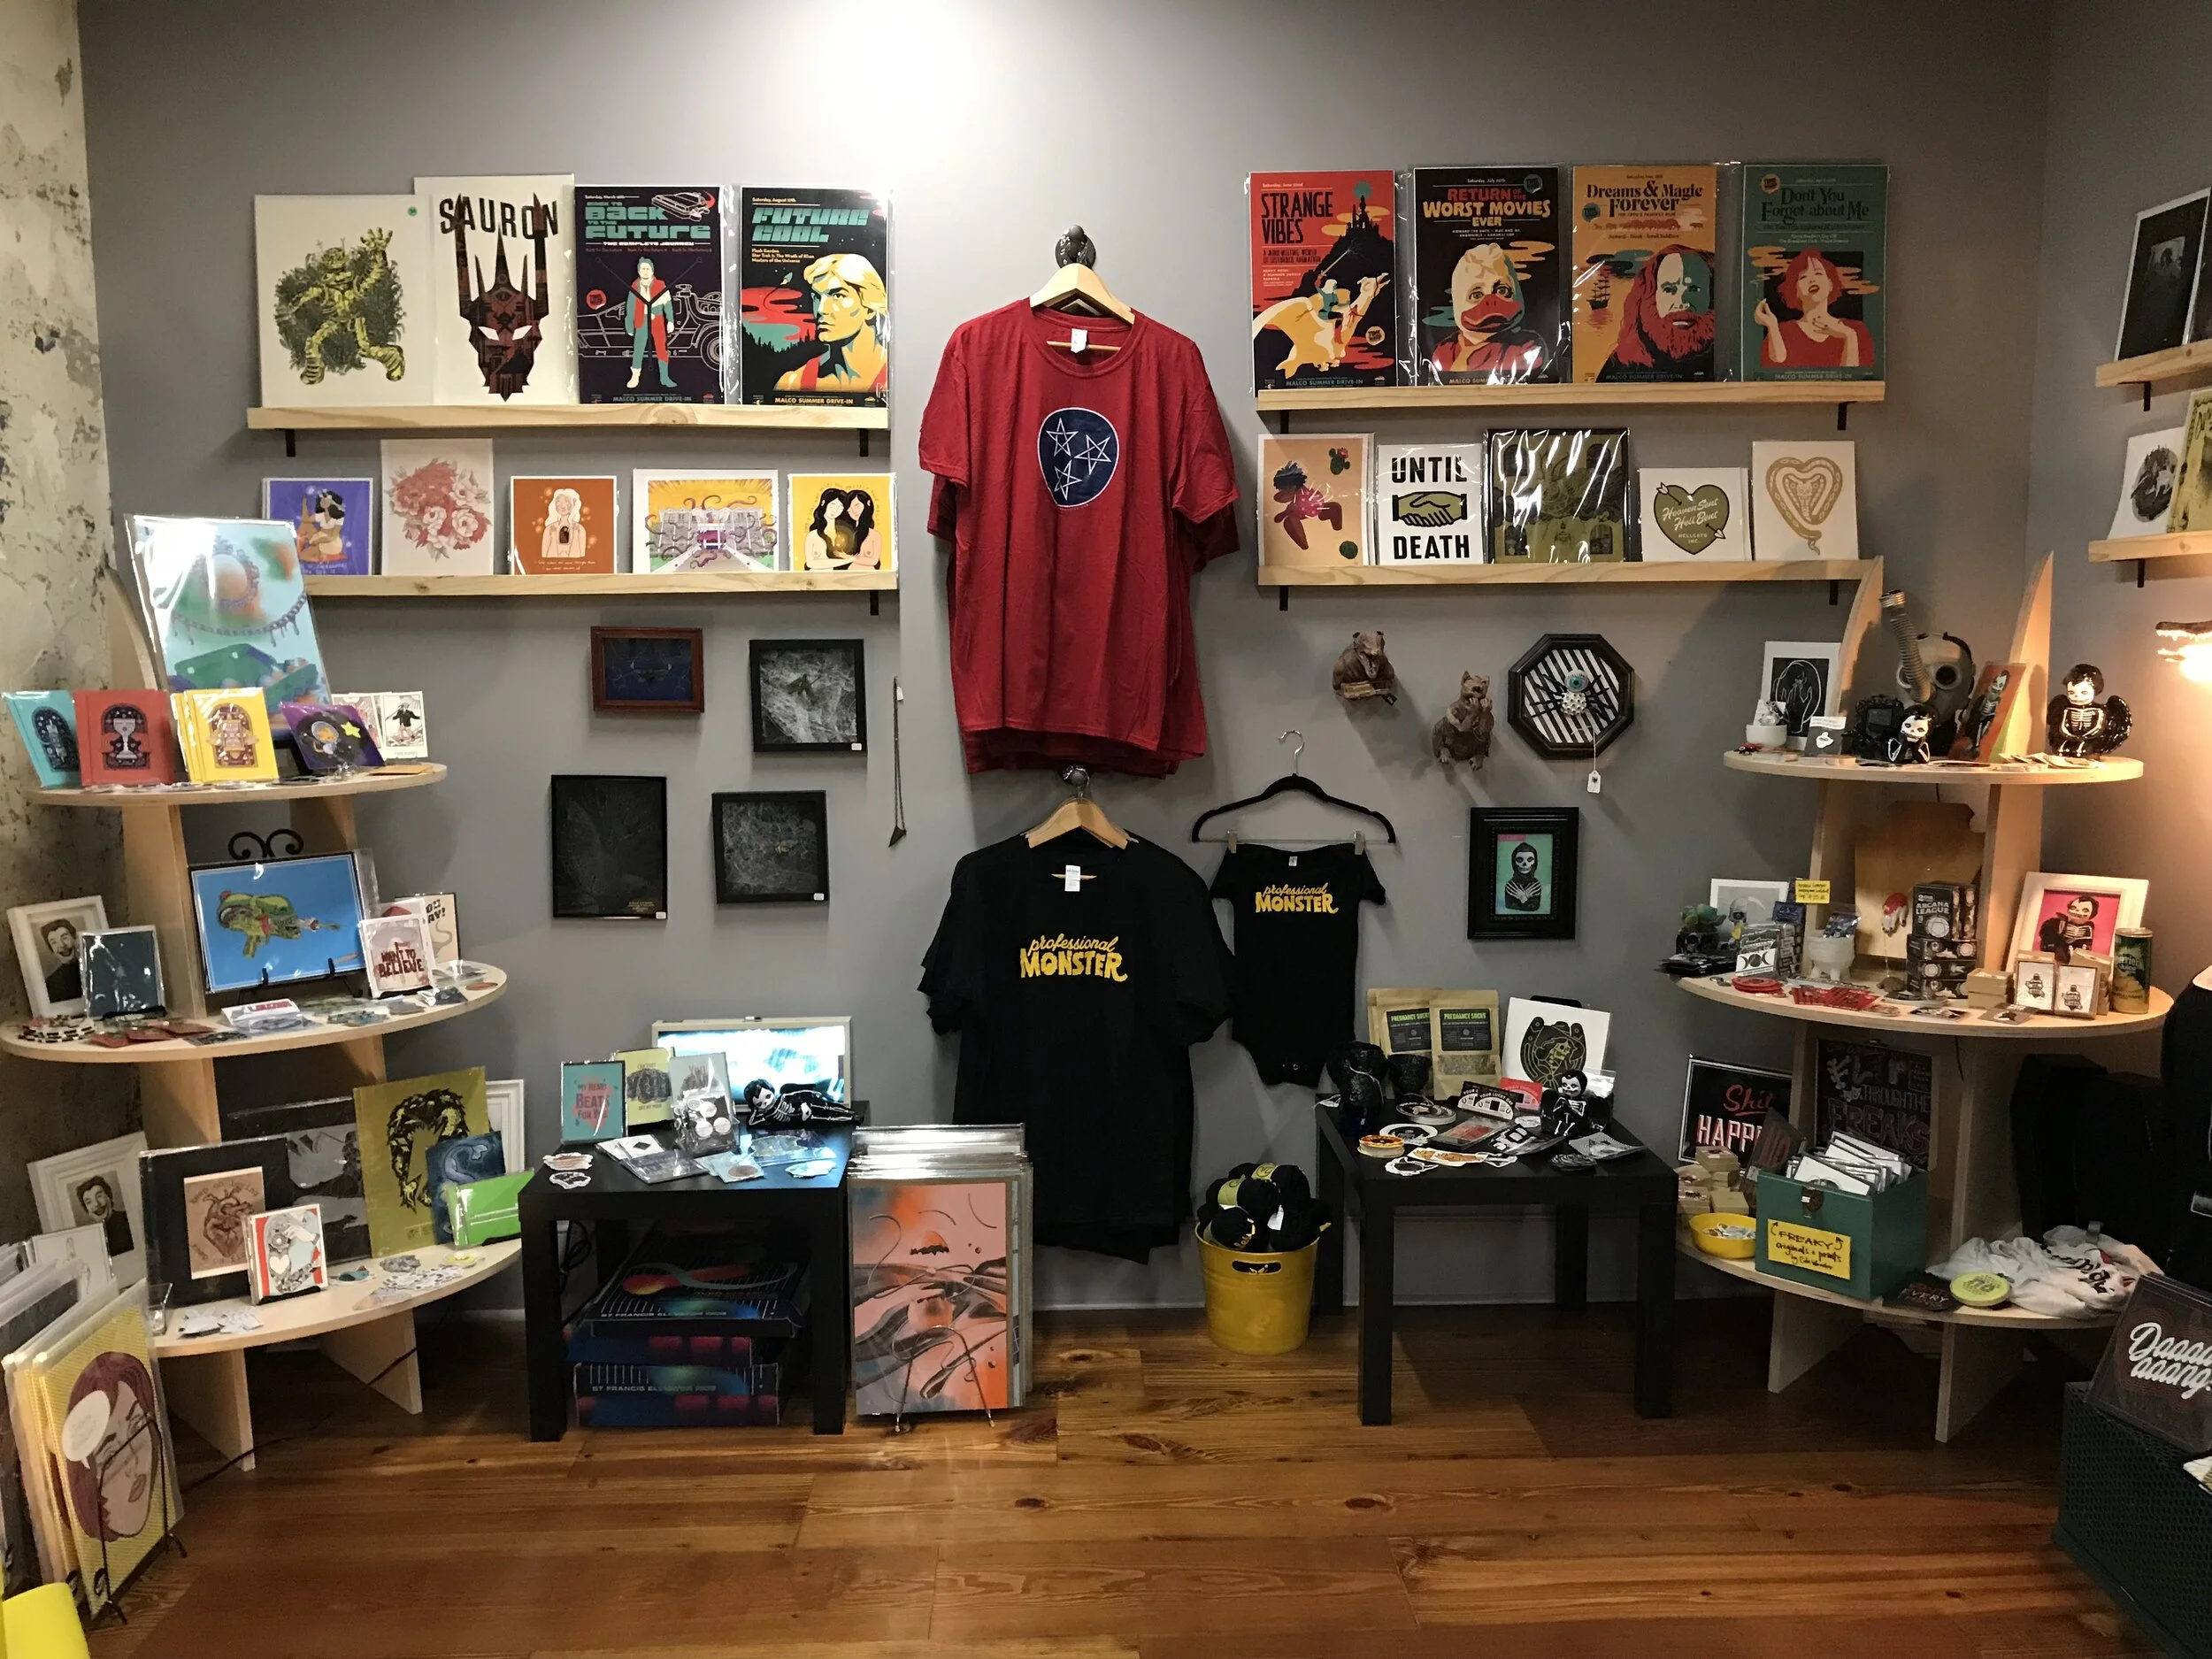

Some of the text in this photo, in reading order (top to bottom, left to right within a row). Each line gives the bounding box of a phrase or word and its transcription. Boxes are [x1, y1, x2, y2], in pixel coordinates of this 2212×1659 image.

[1447, 188, 1511, 201] RETURN
[1587, 180, 1703, 201] Dreams & Magic
[1781, 188, 1845, 204] Don't You
[585, 206, 669, 220] BACK
[1261, 192, 1333, 219] STRANGE
[1423, 200, 1551, 218] WORST MOVIES
[1609, 199, 1680, 217] Forever
[1761, 201, 1869, 225] Forget about Me
[440, 196, 559, 240] SAURON
[752, 207, 870, 226] FUTURE
[1472, 217, 1502, 227] EVER
[585, 226, 711, 239] FUTURE
[752, 225, 830, 242] COOL
[1261, 219, 1303, 244] VIBES
[1392, 457, 1467, 483] UNTIL
[1663, 498, 1718, 521] Heaven Sent
[1674, 511, 1718, 531] Hell Bent
[1393, 534, 1470, 559] DEATH
[1262, 882, 1329, 897] professional
[1255, 891, 1339, 914] MONSTER
[406, 949, 417, 958] TO
[1028, 933, 1119, 956] professional
[378, 958, 425, 978] BELIEVE
[1019, 948, 1128, 982] MONSTER
[576, 1093, 610, 1109] BEATS
[1696, 1114, 1763, 1153] HAPP
[1827, 1096, 1929, 1156] FREAKS
[1778, 1231, 1833, 1250] FREAKY
